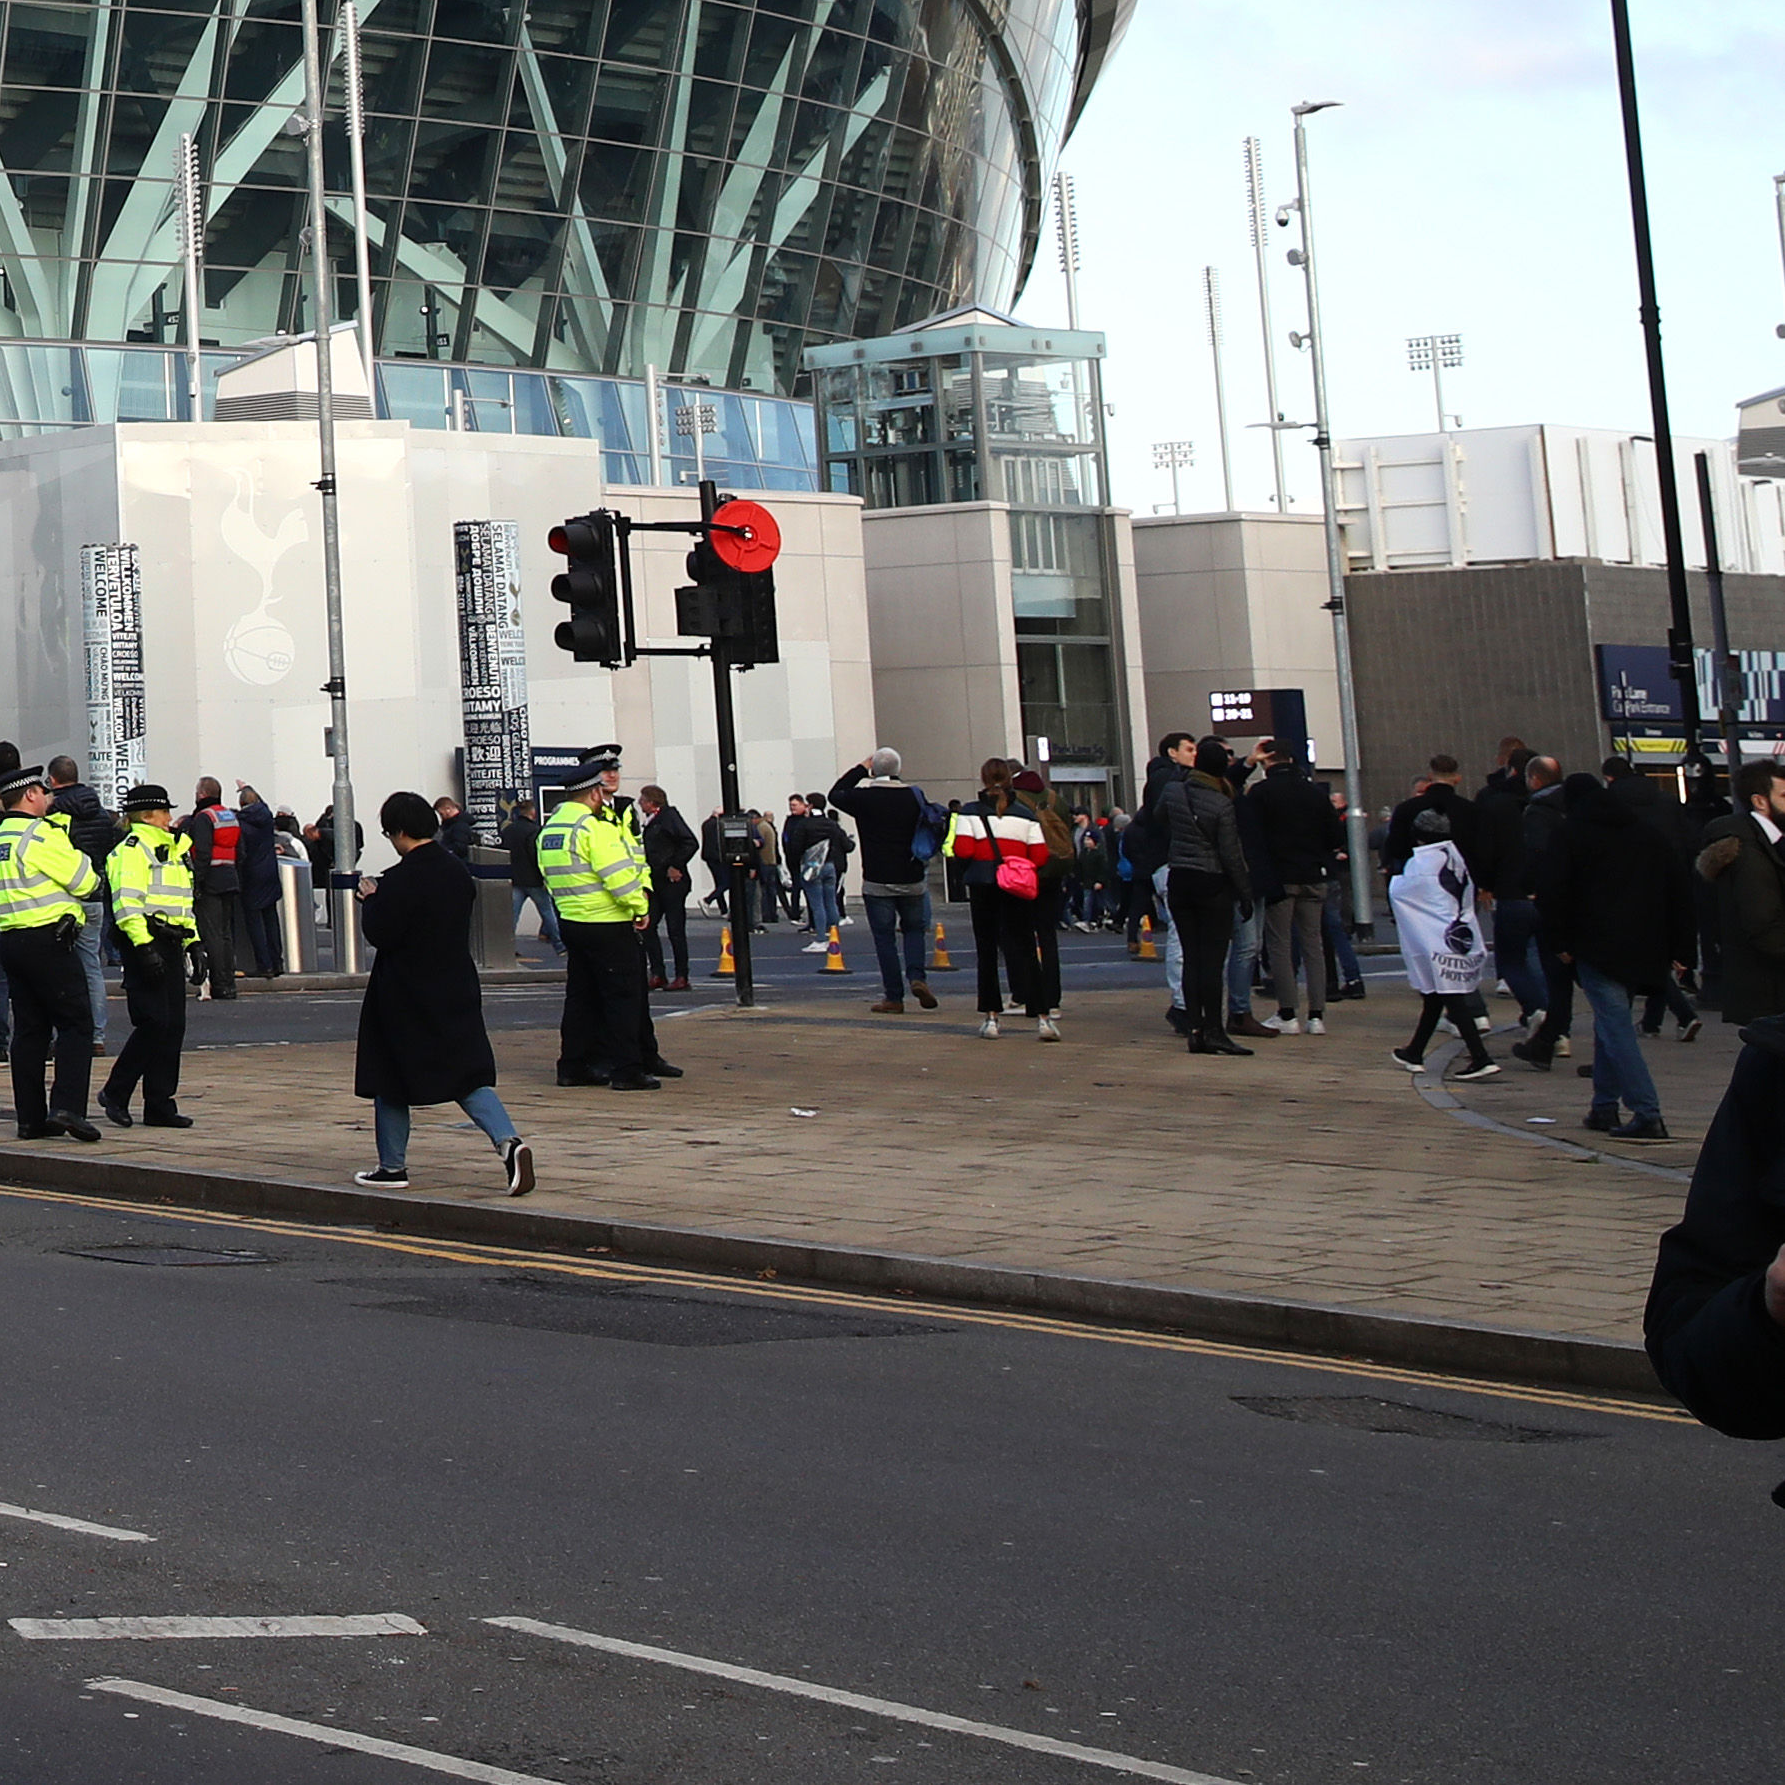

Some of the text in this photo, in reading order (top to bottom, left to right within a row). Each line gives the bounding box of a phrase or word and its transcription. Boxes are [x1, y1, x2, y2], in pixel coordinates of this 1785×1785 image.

[94, 550, 107, 618] WELCOME
[107, 549, 123, 631] TERVETULOA
[120, 548, 134, 632] WILLKOMMEN
[492, 524, 509, 630] SELAMAT DATANG
[534, 756, 580, 766] PROGRAMMES
